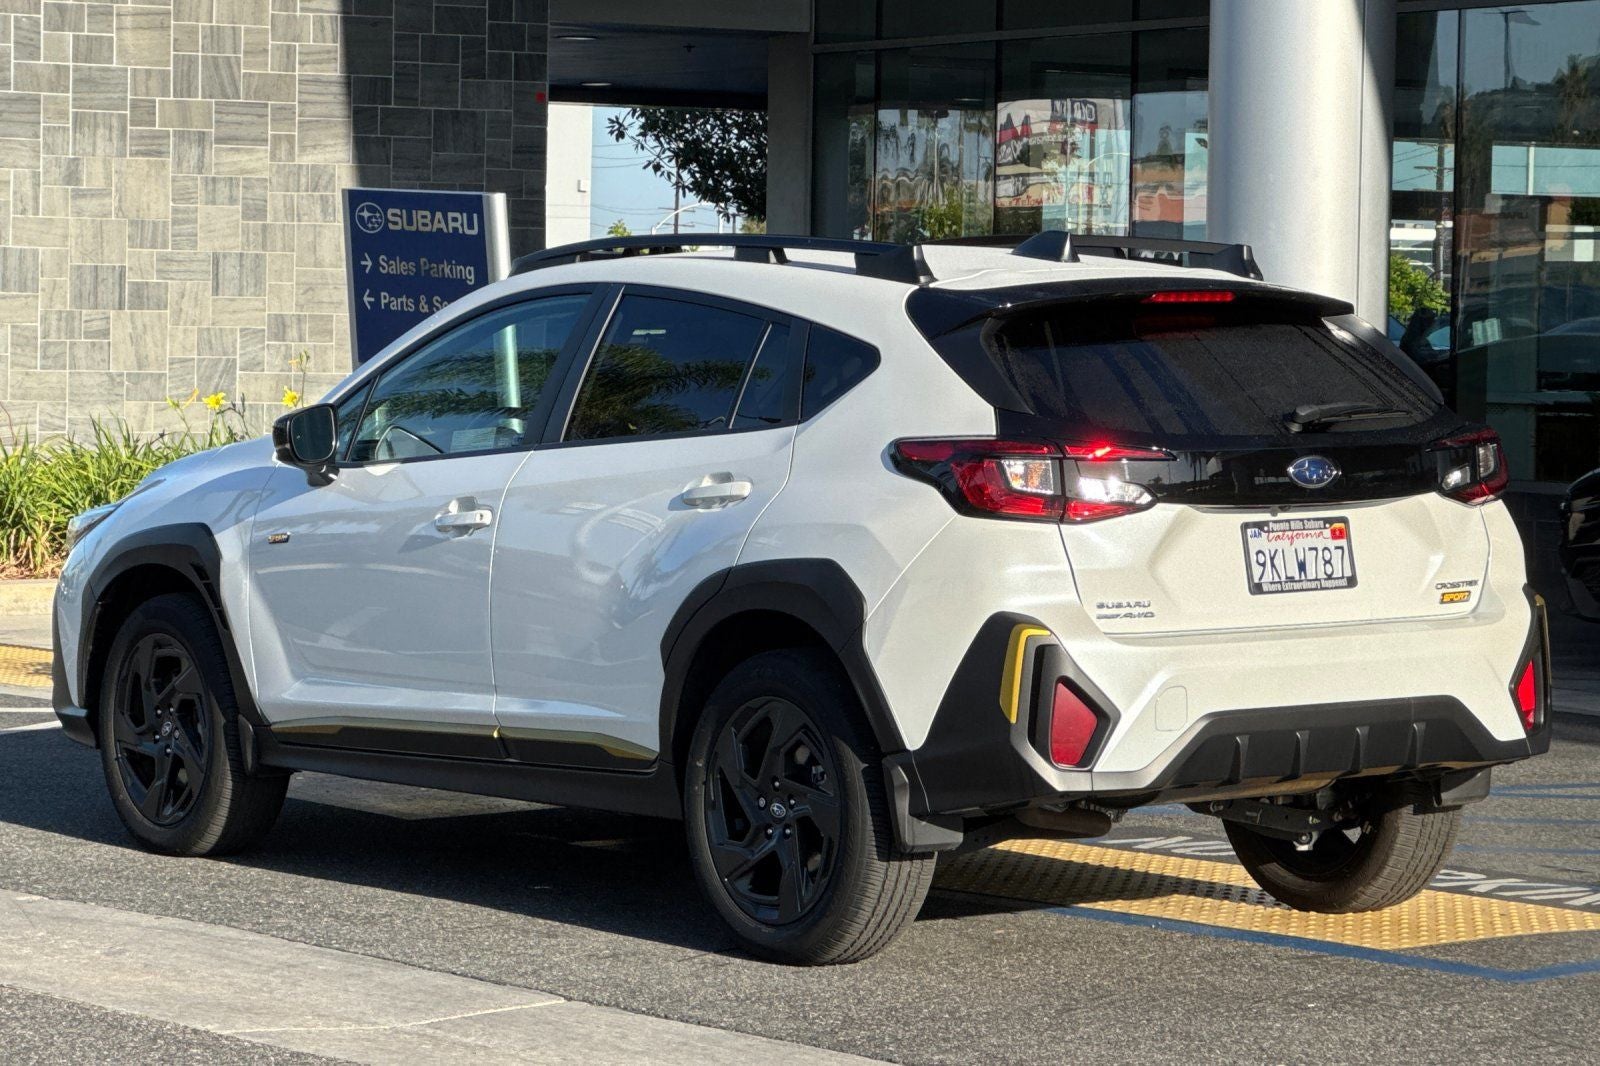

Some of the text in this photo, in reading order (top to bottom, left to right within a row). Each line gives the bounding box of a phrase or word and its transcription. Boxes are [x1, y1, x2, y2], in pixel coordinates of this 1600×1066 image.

[387, 208, 479, 236] SUBARU
[379, 254, 475, 285] Sales Parking
[380, 291, 415, 313] Parts
[419, 294, 430, 313] &
[1266, 529, 1330, 546] California
[1255, 545, 1346, 582] 9KLW787
[1096, 600, 1151, 609] SUBARU
[1443, 592, 1469, 602] SPORT
